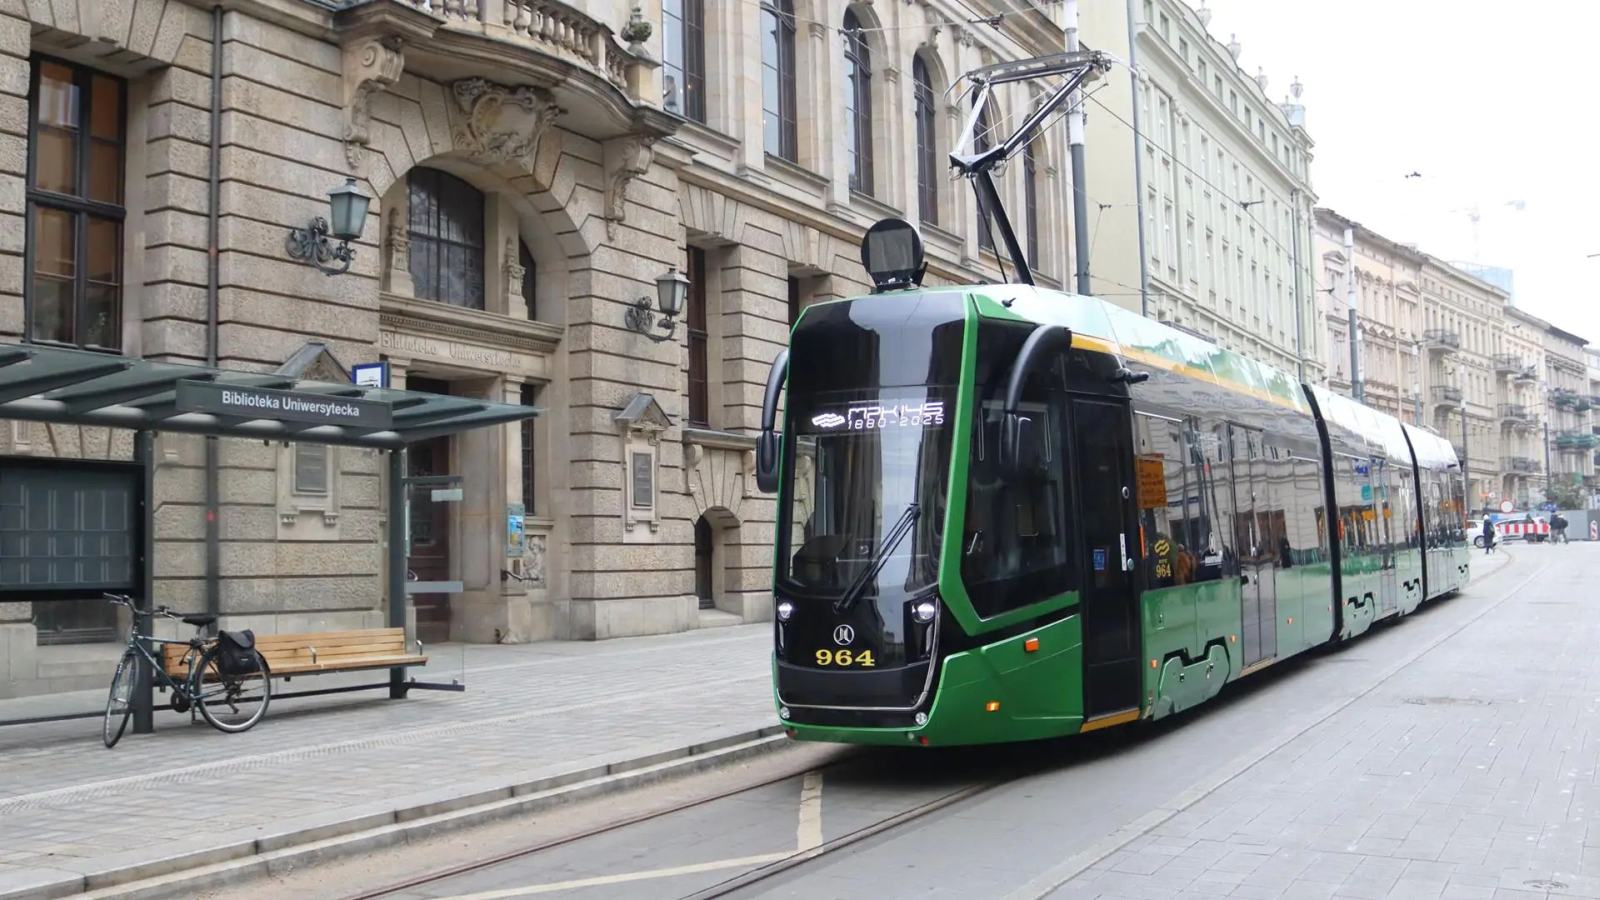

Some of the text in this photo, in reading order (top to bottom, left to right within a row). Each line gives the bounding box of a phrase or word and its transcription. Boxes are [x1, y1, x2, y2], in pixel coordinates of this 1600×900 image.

[222, 390, 360, 417] Biblioteka Uniwersytecka
[847, 414, 944, 430] 1880-2025
[1156, 564, 1171, 578] 964
[815, 649, 875, 667] 964
